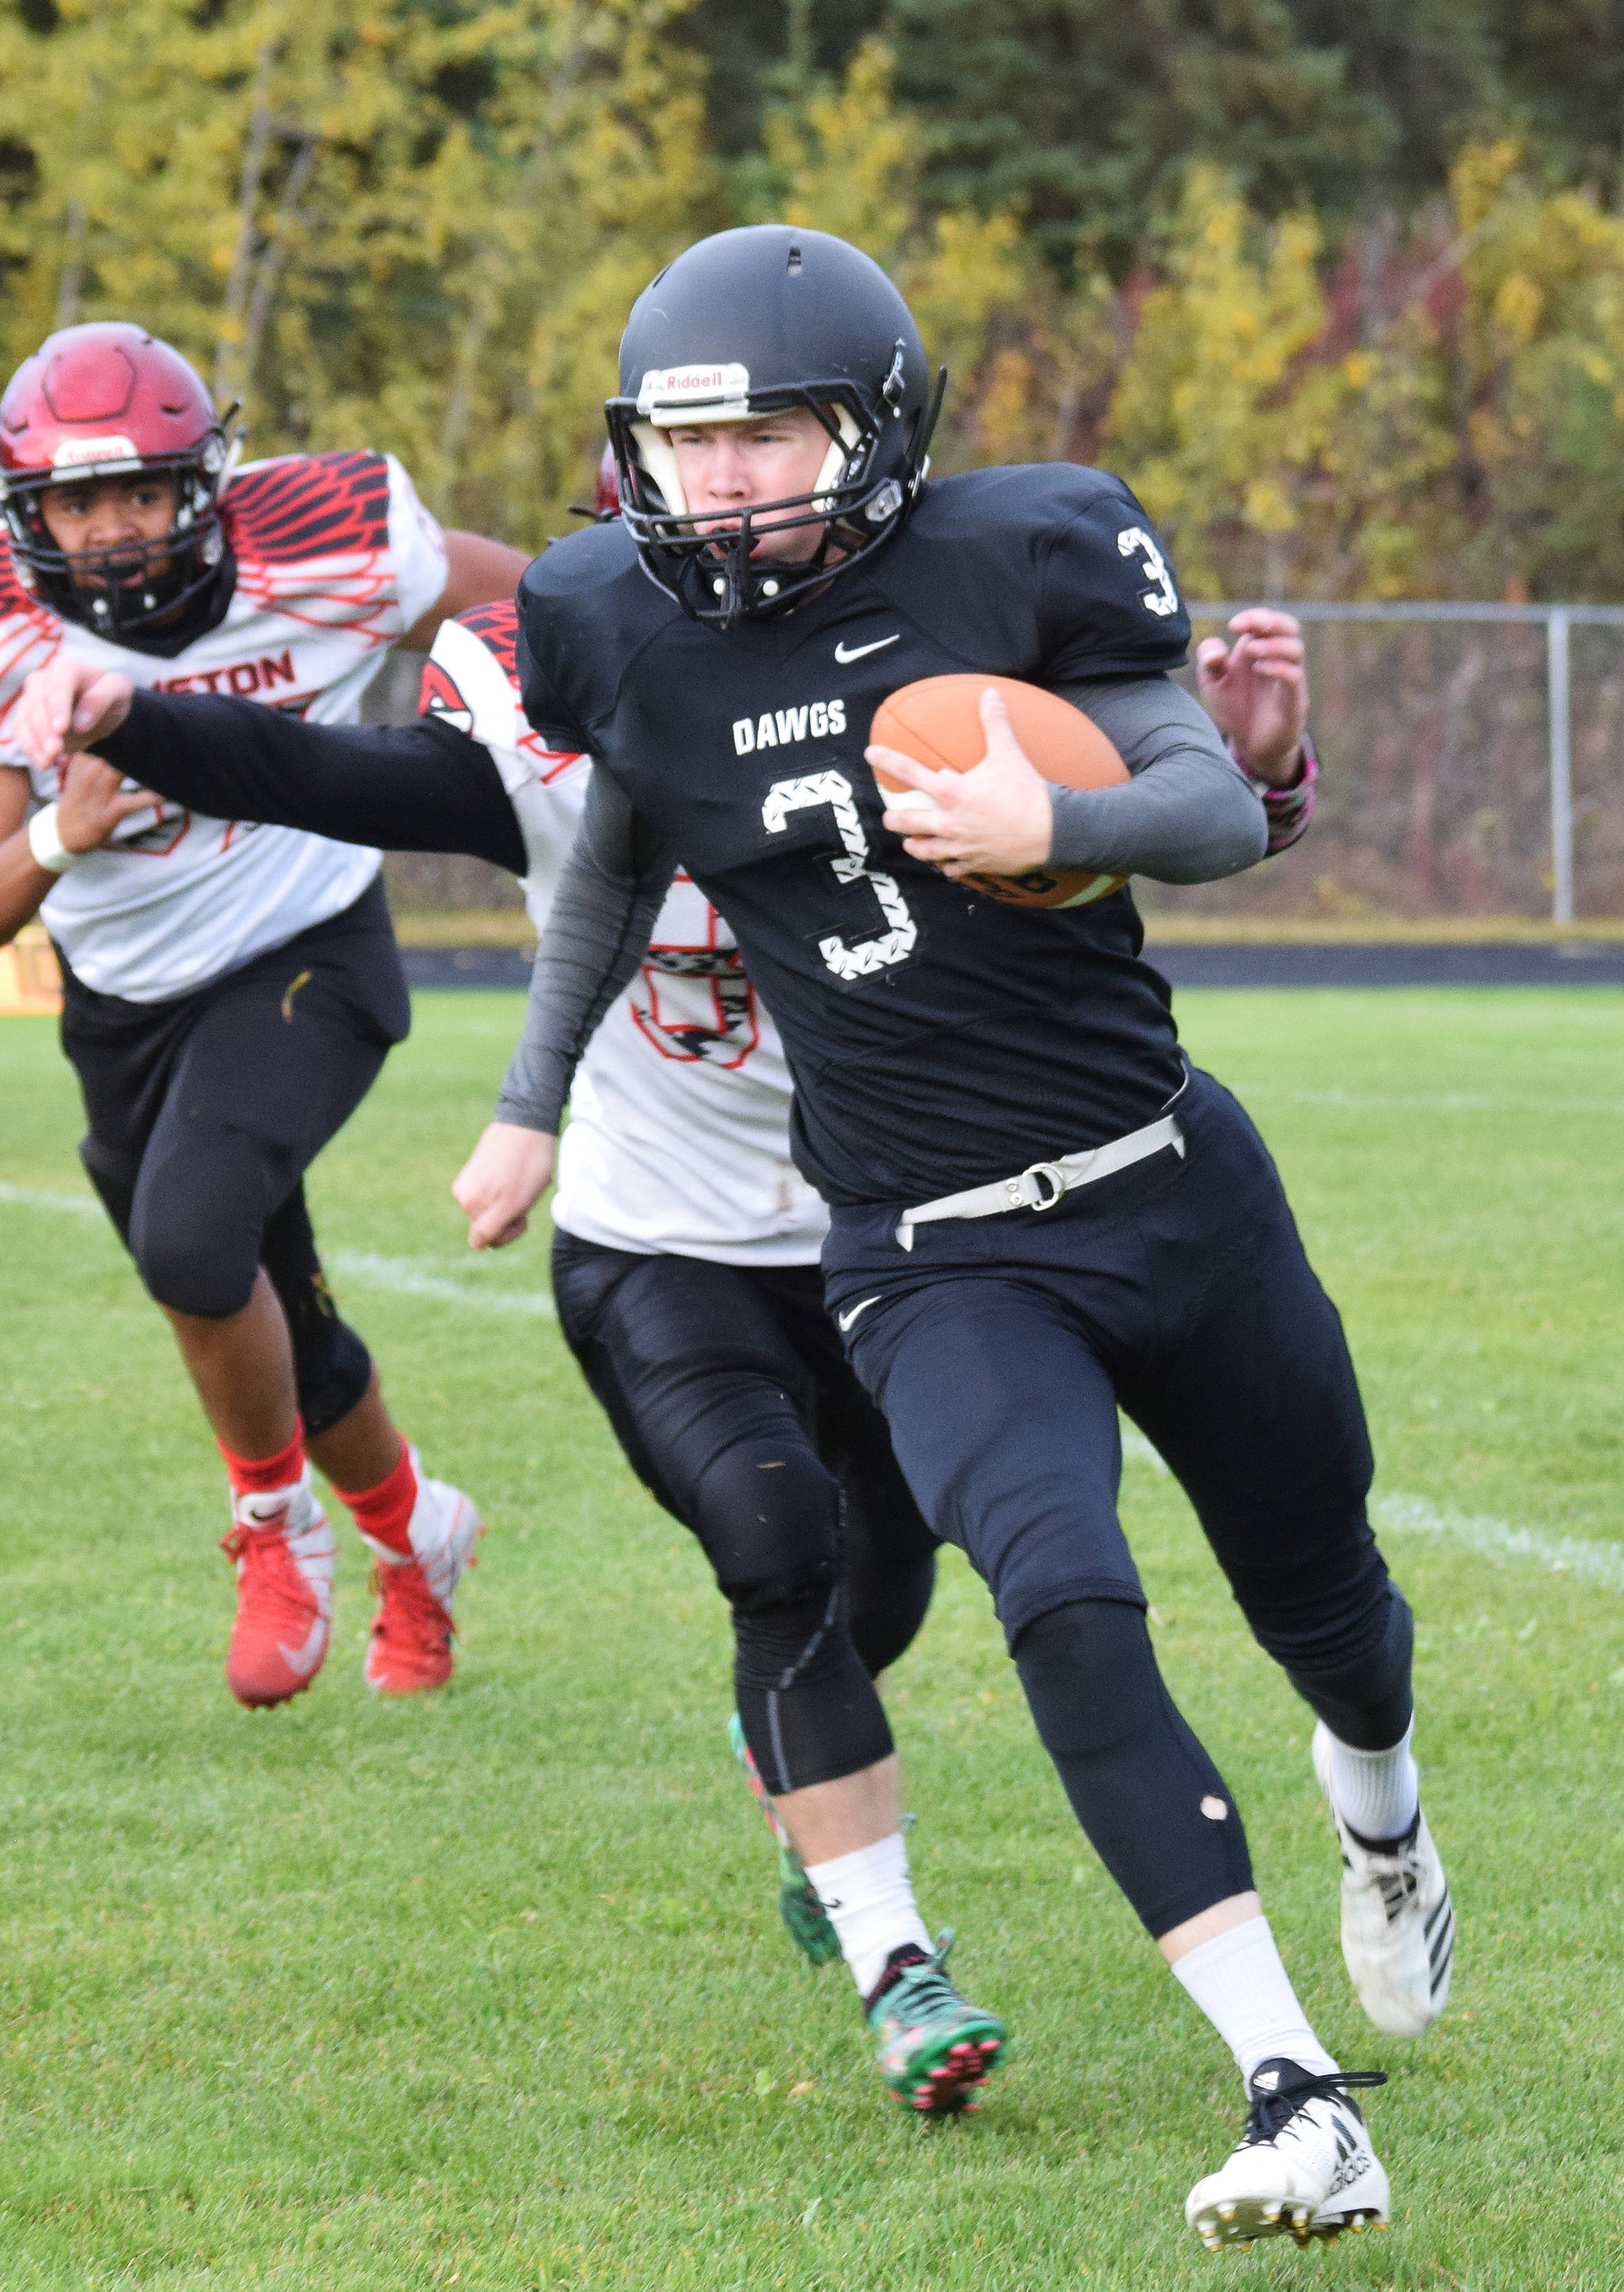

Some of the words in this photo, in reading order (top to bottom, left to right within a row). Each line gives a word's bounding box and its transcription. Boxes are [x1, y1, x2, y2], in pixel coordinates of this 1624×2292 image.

[667, 371, 722, 390] Riddell
[1116, 526, 1178, 617] 3
[732, 699, 847, 756] DAWGS
[760, 768, 918, 981] 3
